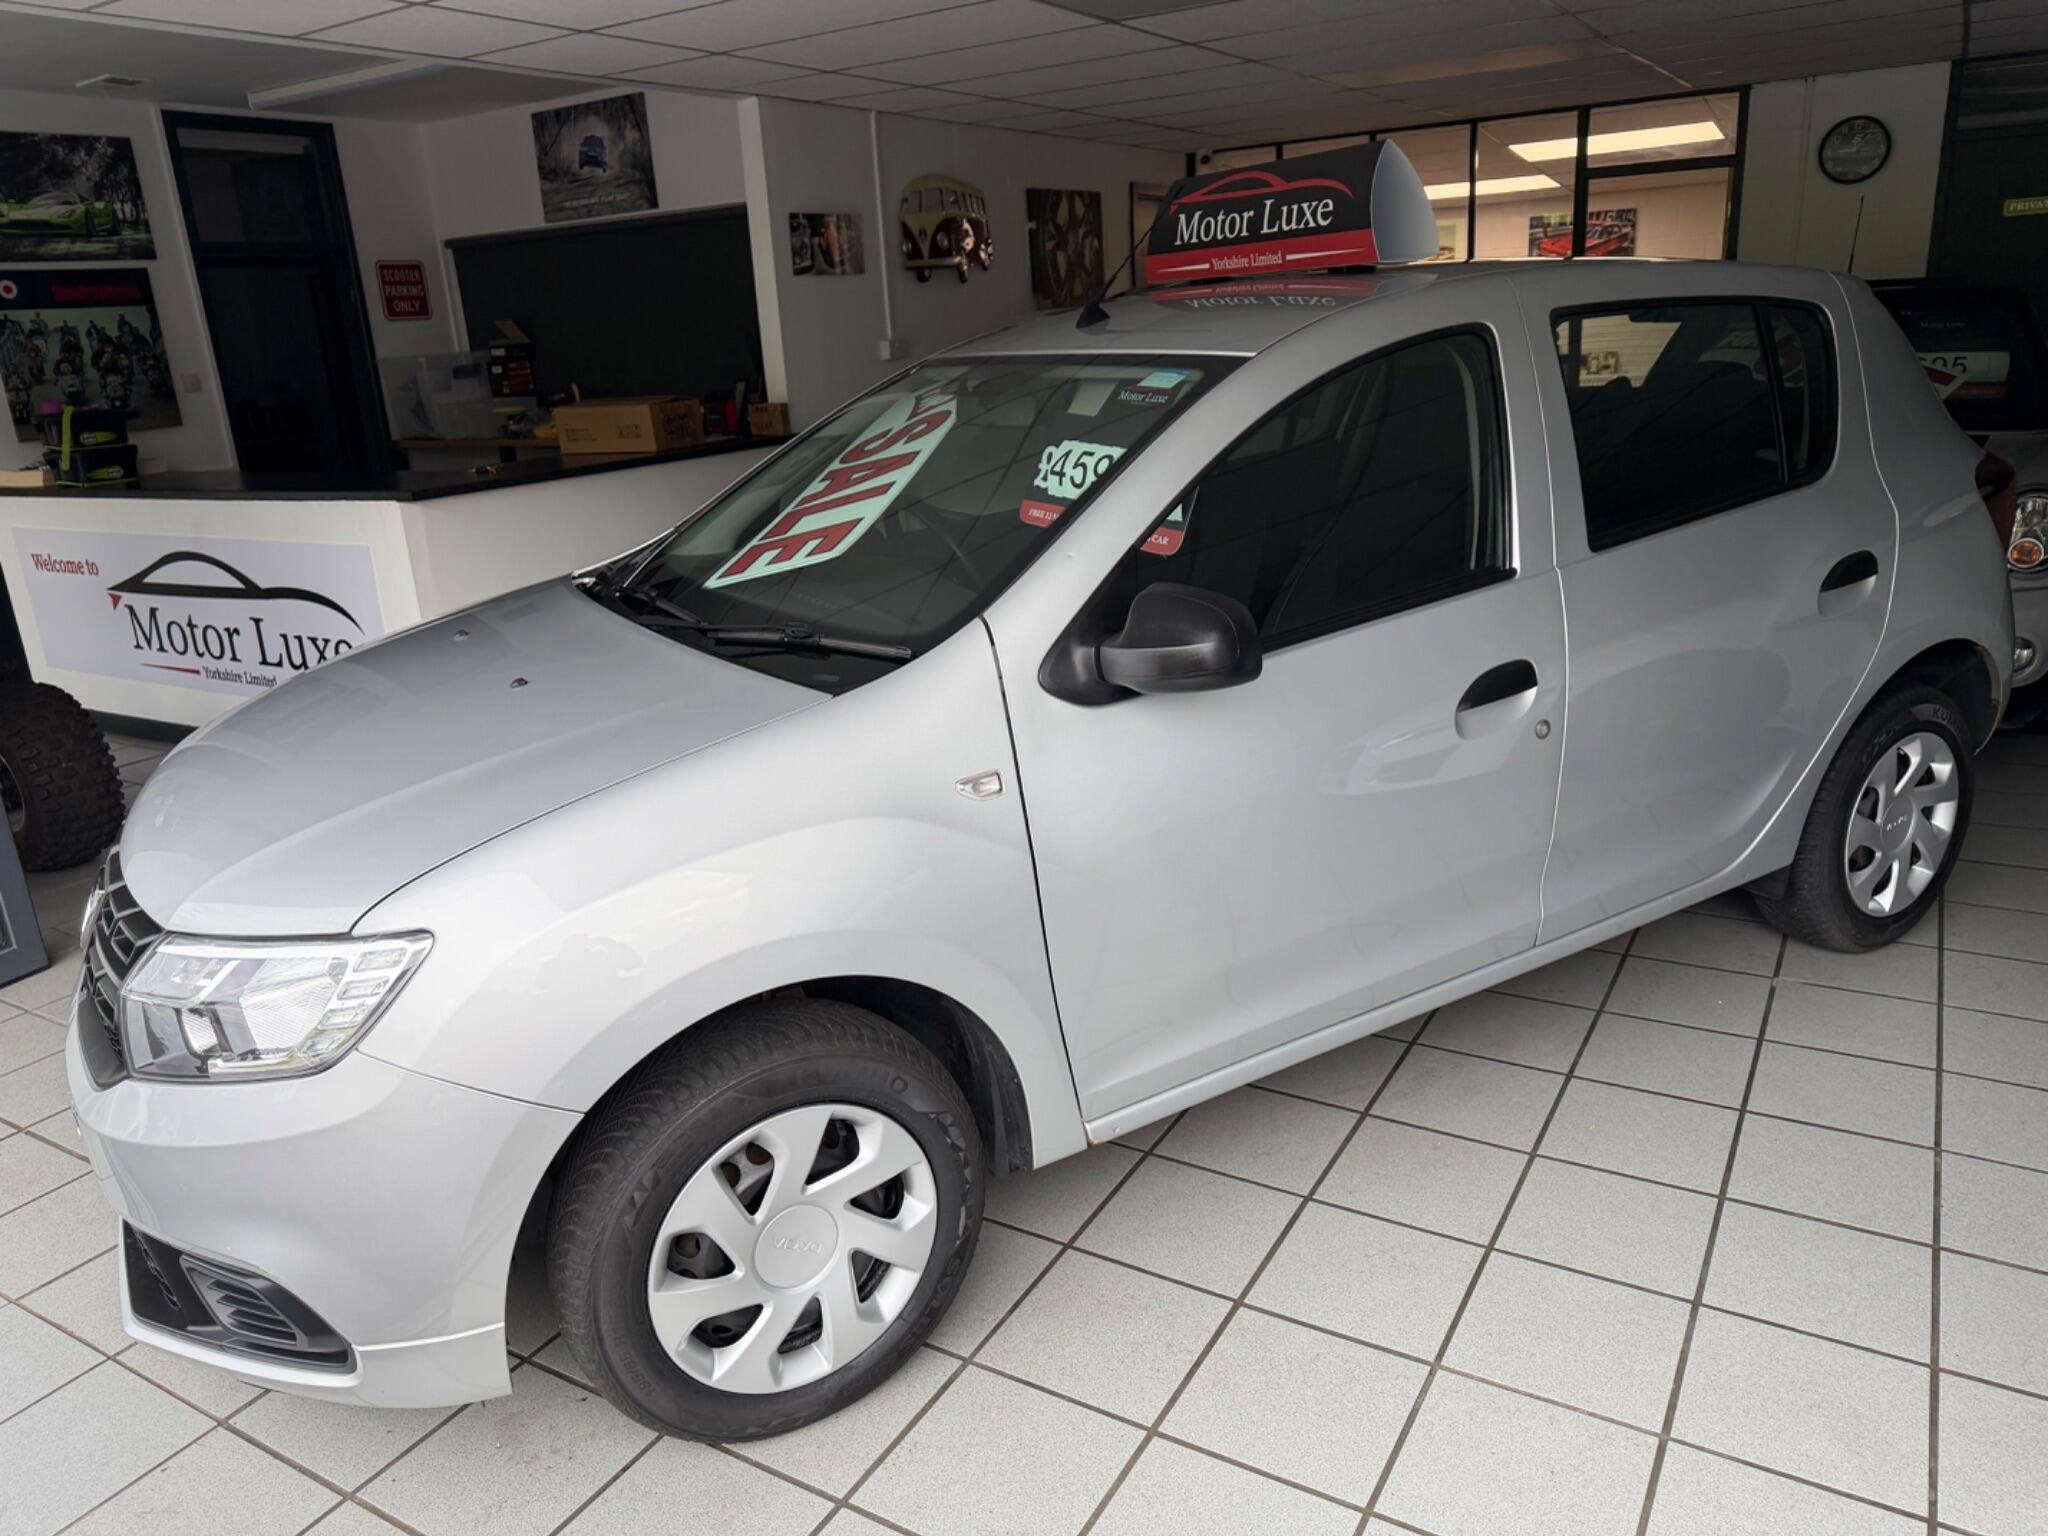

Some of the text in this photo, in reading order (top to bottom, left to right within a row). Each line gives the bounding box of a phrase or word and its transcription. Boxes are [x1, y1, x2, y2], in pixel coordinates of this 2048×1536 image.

[1174, 198, 1335, 246] Motor Luxe
[1210, 251, 1283, 272] Yorkshire Limited
[382, 269, 422, 282] SCOOTER
[384, 284, 425, 297] PARKING
[393, 299, 421, 313] ONLY
[1117, 389, 1147, 402] Motor
[718, 410, 953, 580] SALE
[1152, 534, 1169, 546] CAR
[30, 552, 100, 577] Welcome to
[124, 604, 241, 664] Motor
[202, 666, 244, 686] Yorkshire
